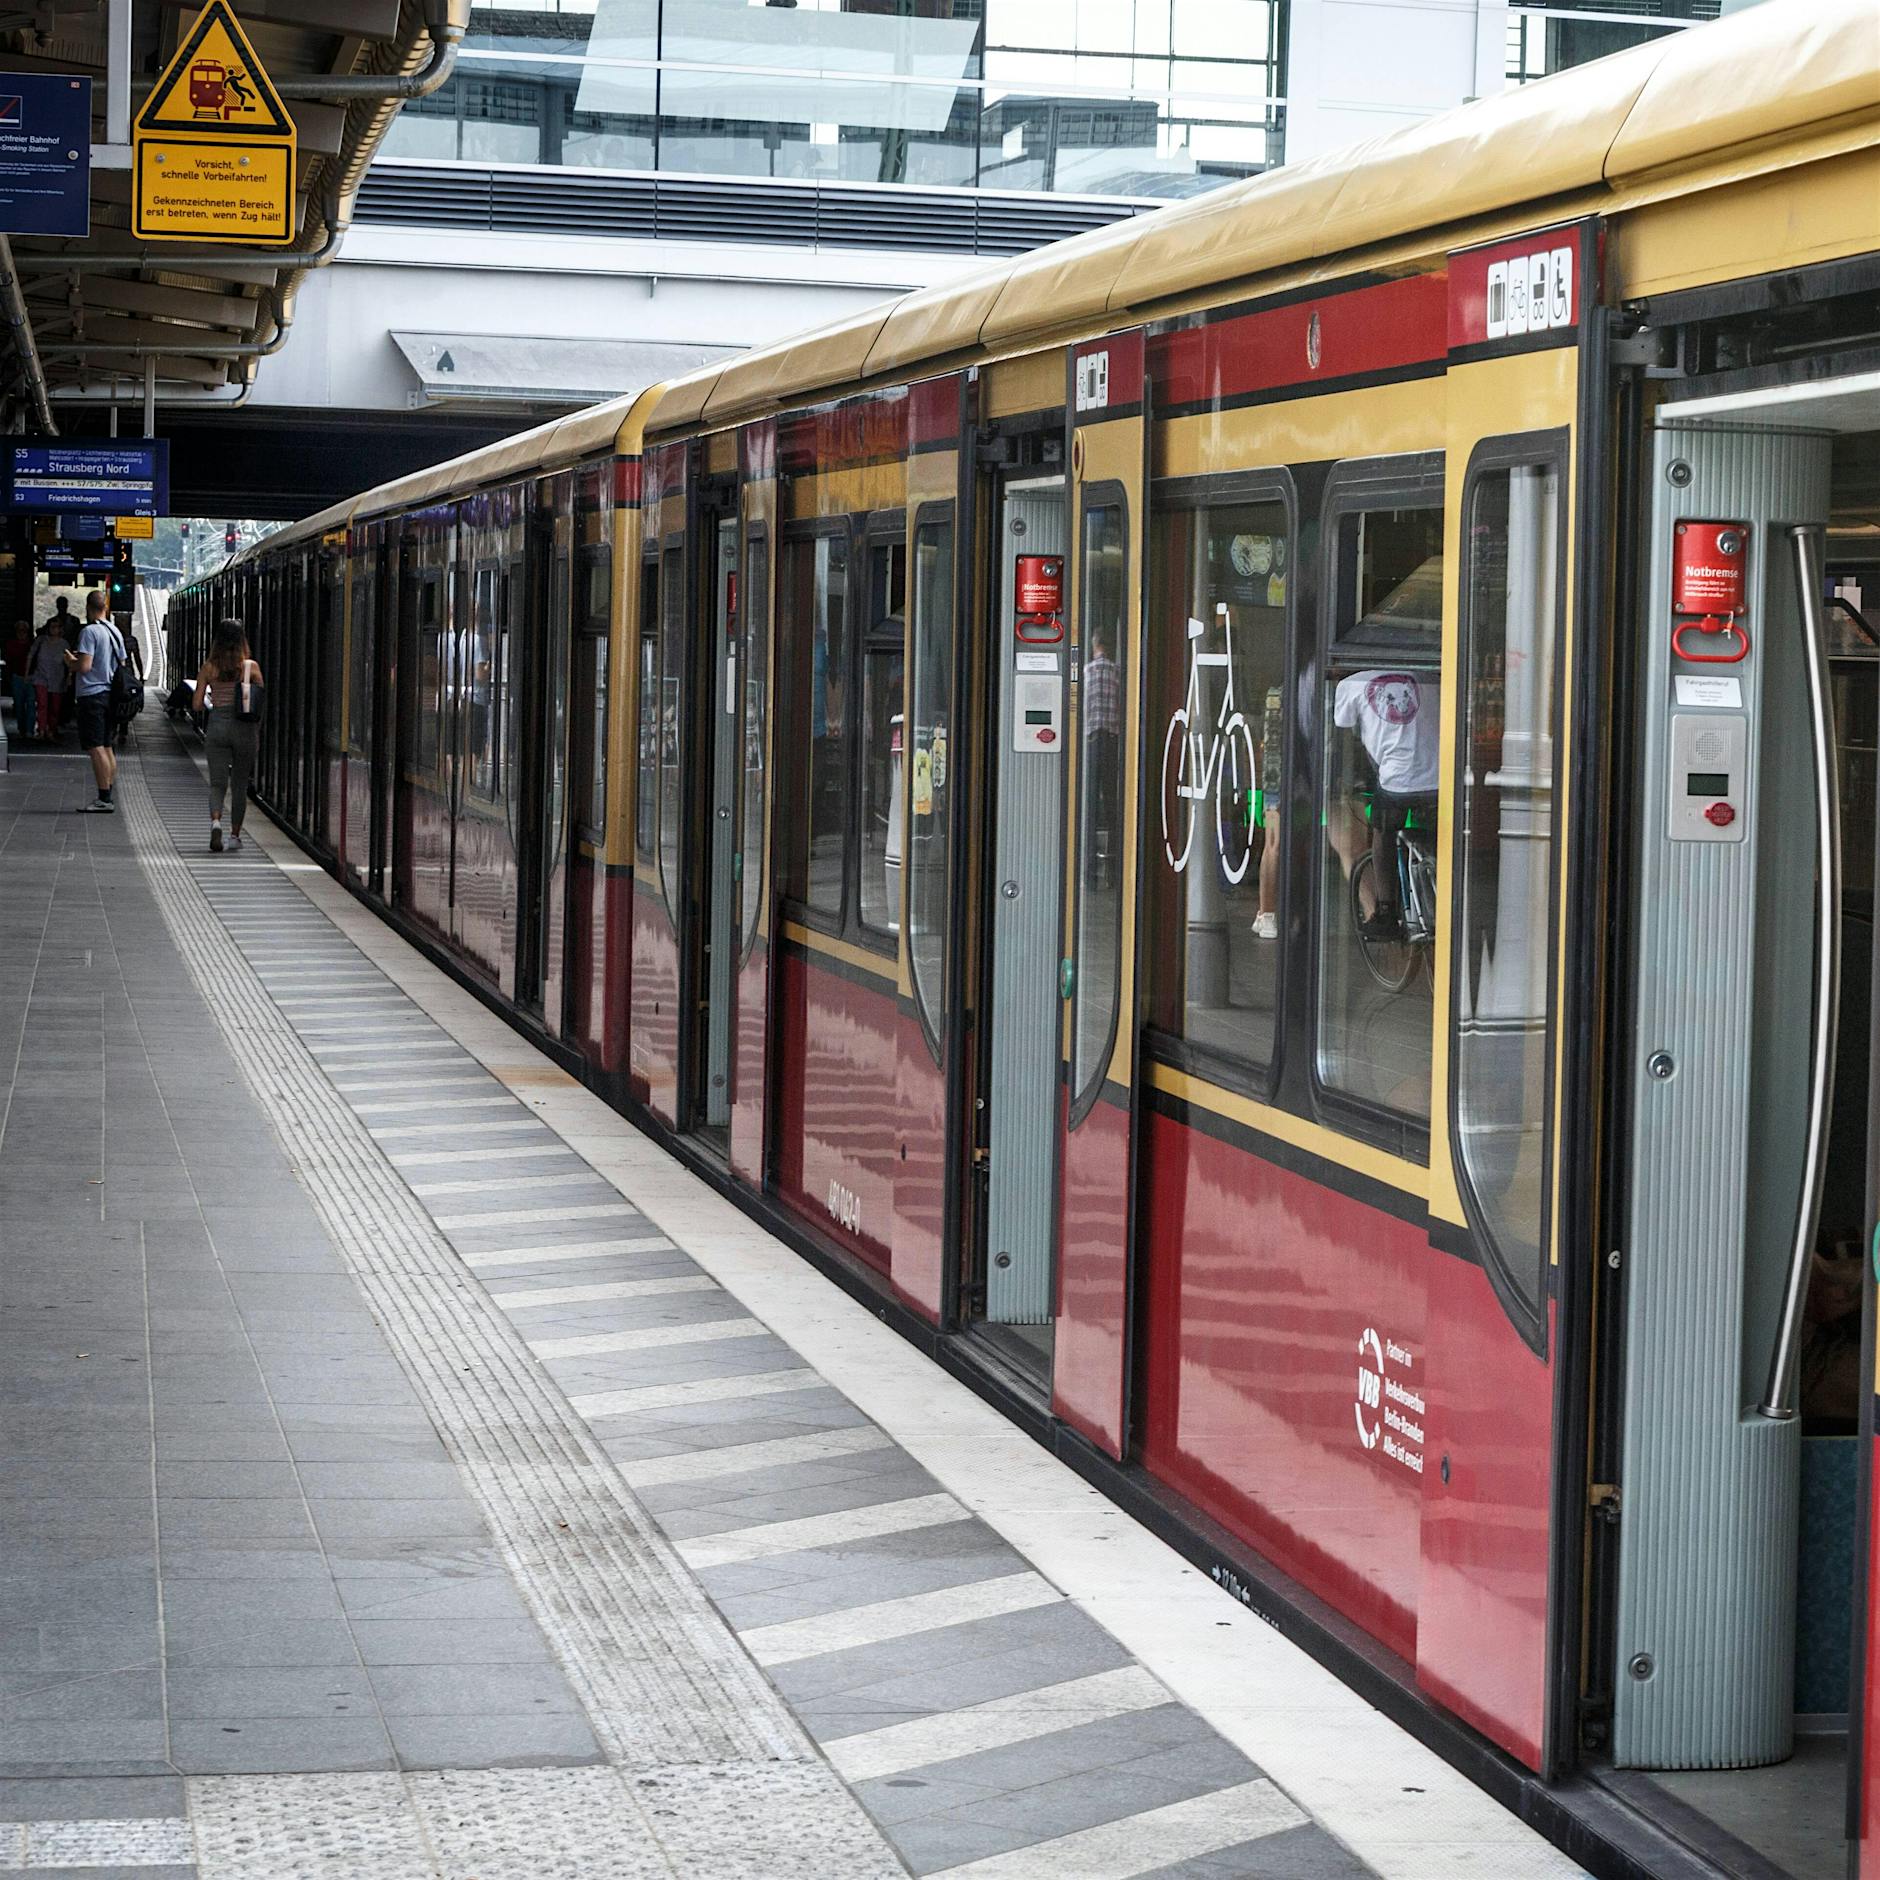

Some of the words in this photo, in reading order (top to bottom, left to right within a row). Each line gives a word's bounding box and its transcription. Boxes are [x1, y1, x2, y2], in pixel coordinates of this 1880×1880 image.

[30, 136, 60, 144] Bahnhof
[195, 159, 234, 170] Vorsicht,
[161, 170, 199, 180] schnelle
[203, 172, 267, 183] Vorbeifahrten!
[153, 196, 236, 207] Gekennzeichneten
[239, 199, 274, 209] Bereich
[146, 208, 164, 217] erst
[167, 209, 209, 219] betreten,
[241, 211, 258, 222] Zug
[261, 210, 281, 222] hält!
[15, 448, 28, 458] S5
[49, 462, 102, 475] Strausberg
[106, 463, 129, 474] Nord
[15, 493, 24, 501] S3
[48, 494, 101, 503] Friedrichshagen
[1685, 565, 1739, 578] Notbremse
[1023, 583, 1058, 591] Notbremse
[1358, 1366, 1380, 1409] VBB
[1383, 1435, 1396, 1459] Alles
